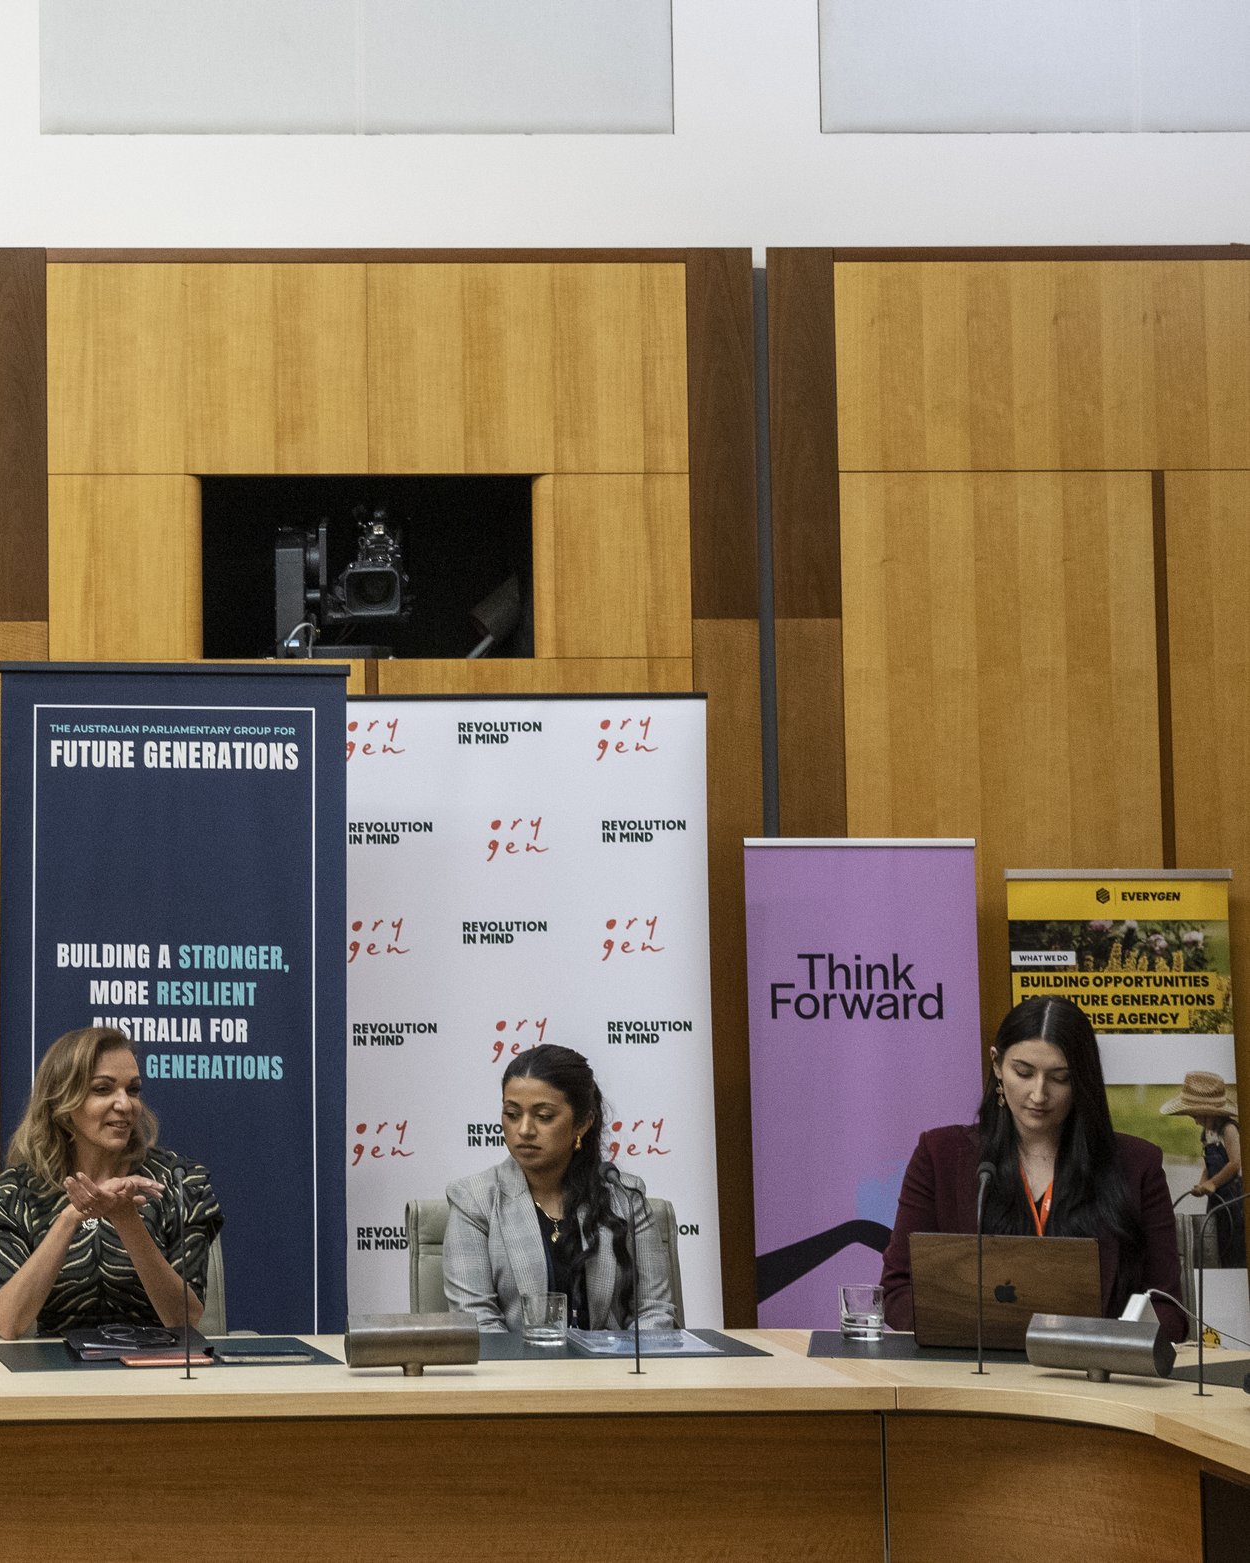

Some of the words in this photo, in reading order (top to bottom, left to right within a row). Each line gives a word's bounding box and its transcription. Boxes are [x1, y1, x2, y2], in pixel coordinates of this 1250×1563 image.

[50, 724, 71, 733] THE
[73, 724, 140, 734] AUSTRALIAN
[142, 725, 232, 735] PARLIAMENTARY
[234, 726, 272, 736] GROUP
[274, 726, 296, 736] FOR
[458, 721, 542, 733] REVOLUTION
[458, 733, 472, 745] IN
[475, 733, 509, 745] MIND
[50, 740, 135, 768] FUTURE
[143, 741, 299, 771] GENERATIONS
[346, 741, 406, 761] gen
[596, 739, 659, 761] gen
[348, 821, 433, 833] REVOLUTION
[602, 819, 687, 831] REVOLUTION
[348, 834, 363, 845] IN
[365, 834, 400, 845] MIND
[602, 832, 616, 843] IN
[619, 832, 654, 843] MIND
[487, 840, 549, 862] gen
[1121, 891, 1181, 902] EVERYGEN
[462, 921, 548, 932] REVOLUTION
[462, 933, 477, 945] IN
[480, 933, 515, 945] MIND
[348, 941, 410, 963] gen
[602, 939, 665, 962] gen
[57, 943, 150, 969] BUILDING
[158, 944, 171, 969] A
[178, 945, 290, 973] STRONGER,
[1019, 954, 1043, 962] WHAT
[1044, 954, 1056, 962] WE
[1057, 954, 1069, 962] DO
[797, 953, 916, 990] Think
[1020, 976, 1090, 988] BUILDING
[1092, 975, 1210, 988] OPPORTUNITIES
[90, 980, 149, 1005] MORE
[156, 981, 257, 1007] RESILIENT
[770, 983, 944, 1020] Forward
[1061, 994, 1108, 1006] TURE
[1110, 994, 1216, 1007] GENERATIONS
[1117, 1012, 1180, 1025] AGENCY
[209, 1017, 248, 1043] FOR
[352, 1022, 438, 1034] REVOLUTION
[607, 1020, 693, 1032] REVOLUTION
[352, 1035, 367, 1047] IN
[370, 1034, 405, 1047] MIND
[607, 1033, 622, 1045] IN
[625, 1033, 660, 1045] MIND
[492, 1041, 536, 1063] ge
[146, 1054, 284, 1080] GENERATIONS
[468, 1136, 482, 1147] IN
[485, 1136, 507, 1147] MIN
[352, 1142, 414, 1166] gen
[610, 1142, 672, 1163] gen
[356, 1226, 407, 1239] REVOLU
[357, 1239, 371, 1250] IN
[374, 1239, 409, 1250] MIND
